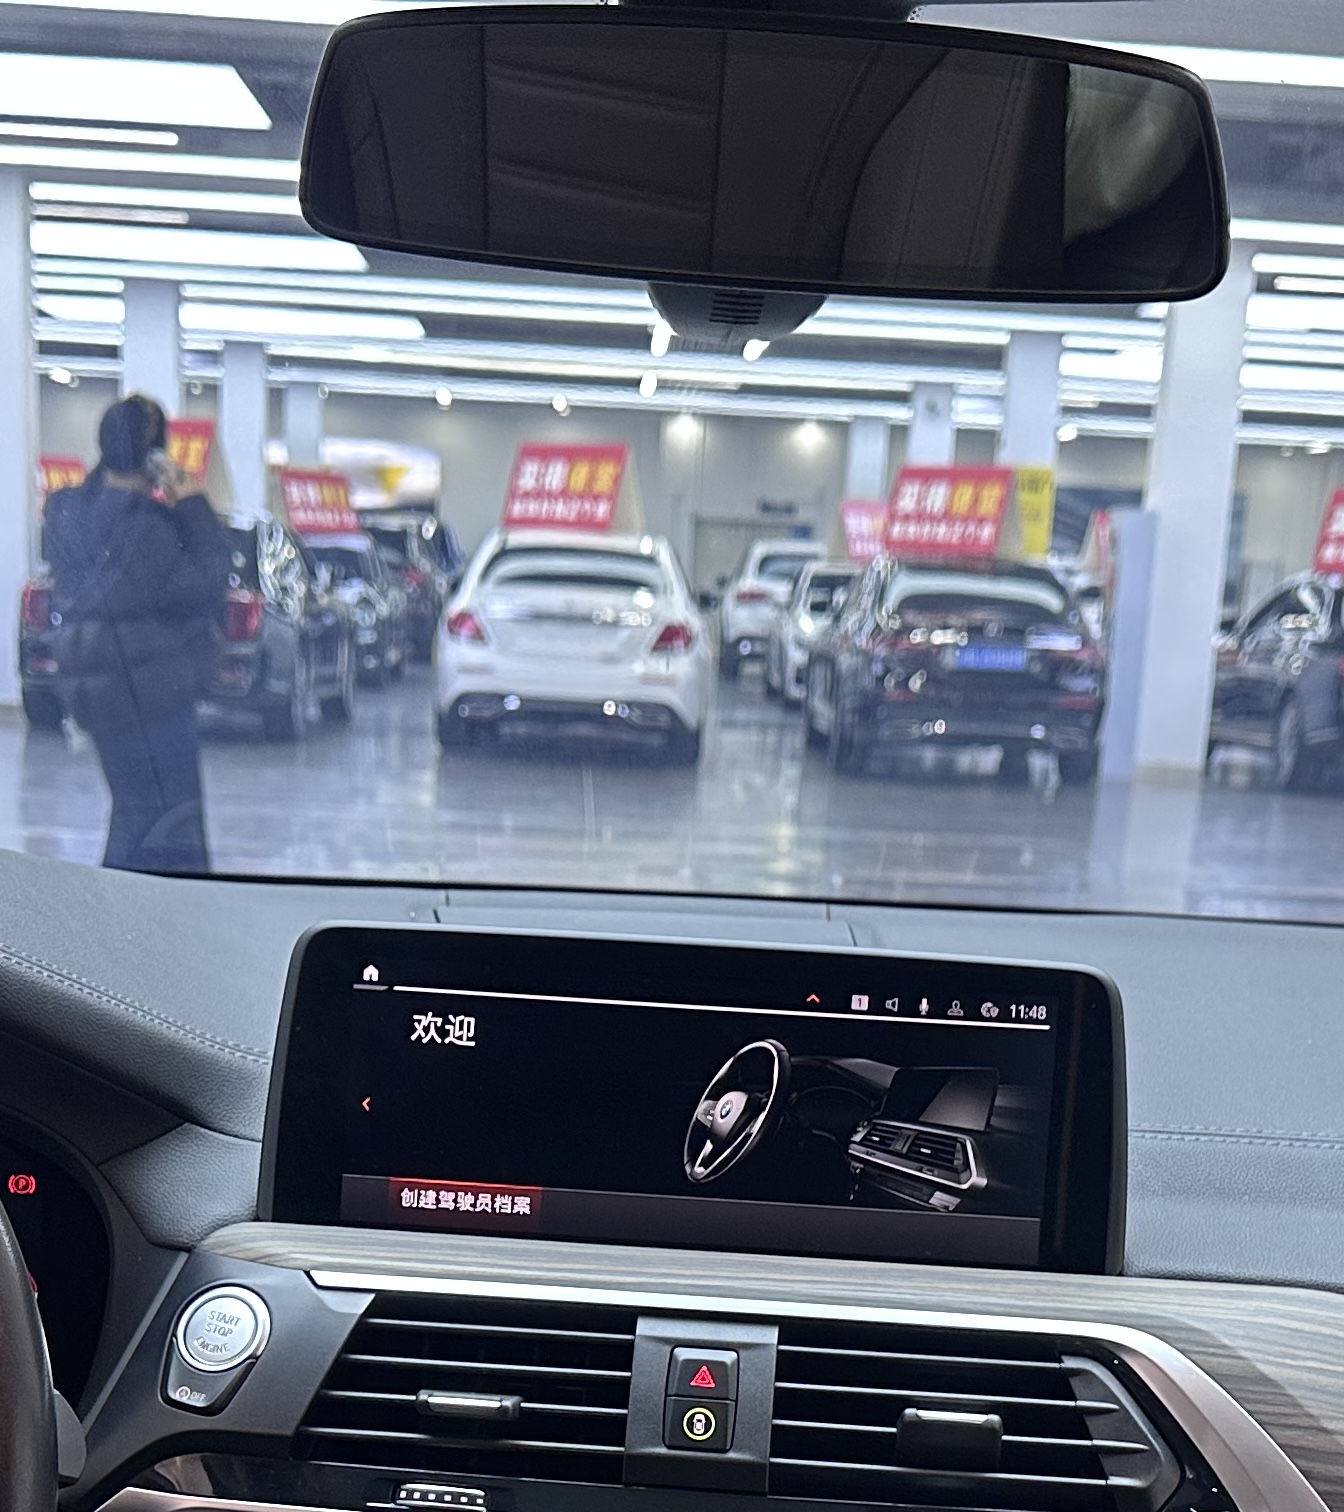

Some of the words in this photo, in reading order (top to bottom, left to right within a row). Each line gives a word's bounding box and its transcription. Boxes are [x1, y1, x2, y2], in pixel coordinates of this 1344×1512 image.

[1009, 1003, 1047, 1020] 11:48
[410, 1011, 477, 1047] 欢迎
[400, 1187, 531, 1215] 创建驾驶员档案
[208, 1310, 242, 1327] START
[205, 1323, 233, 1338] STOP
